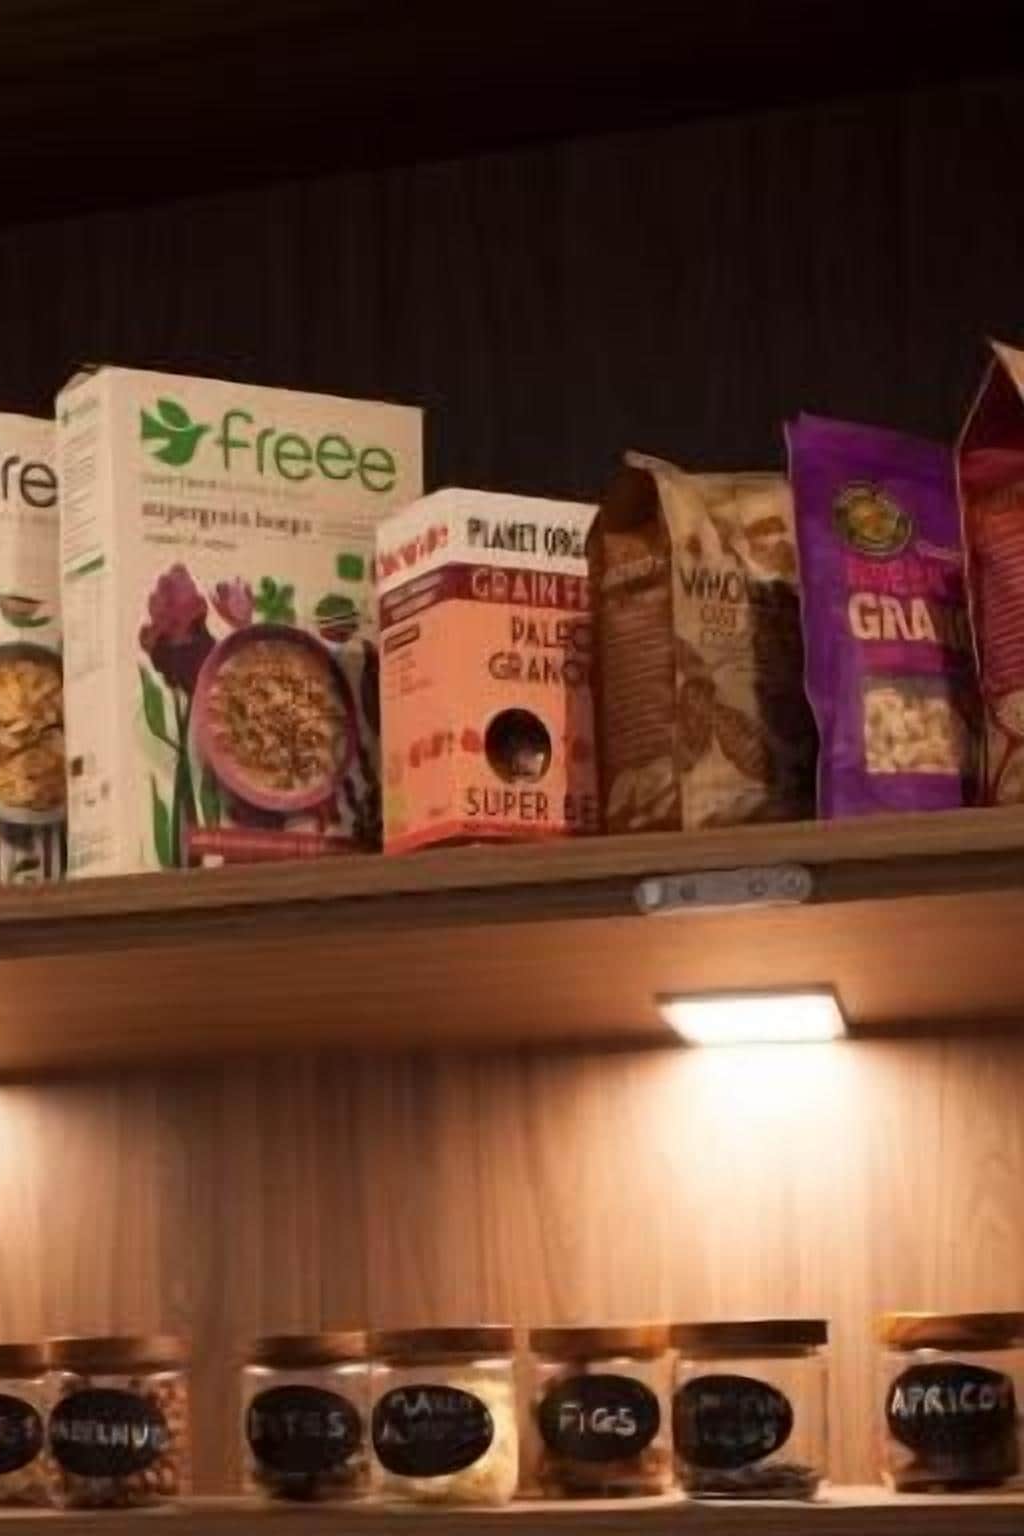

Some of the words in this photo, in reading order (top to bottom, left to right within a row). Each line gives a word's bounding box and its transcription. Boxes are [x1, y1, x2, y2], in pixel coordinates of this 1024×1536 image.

[217, 409, 396, 492] freee
[467, 517, 536, 551] PLANET
[471, 566, 558, 605] GRAIN
[466, 788, 549, 820] SUPER
[559, 1402, 638, 1438] FIGS
